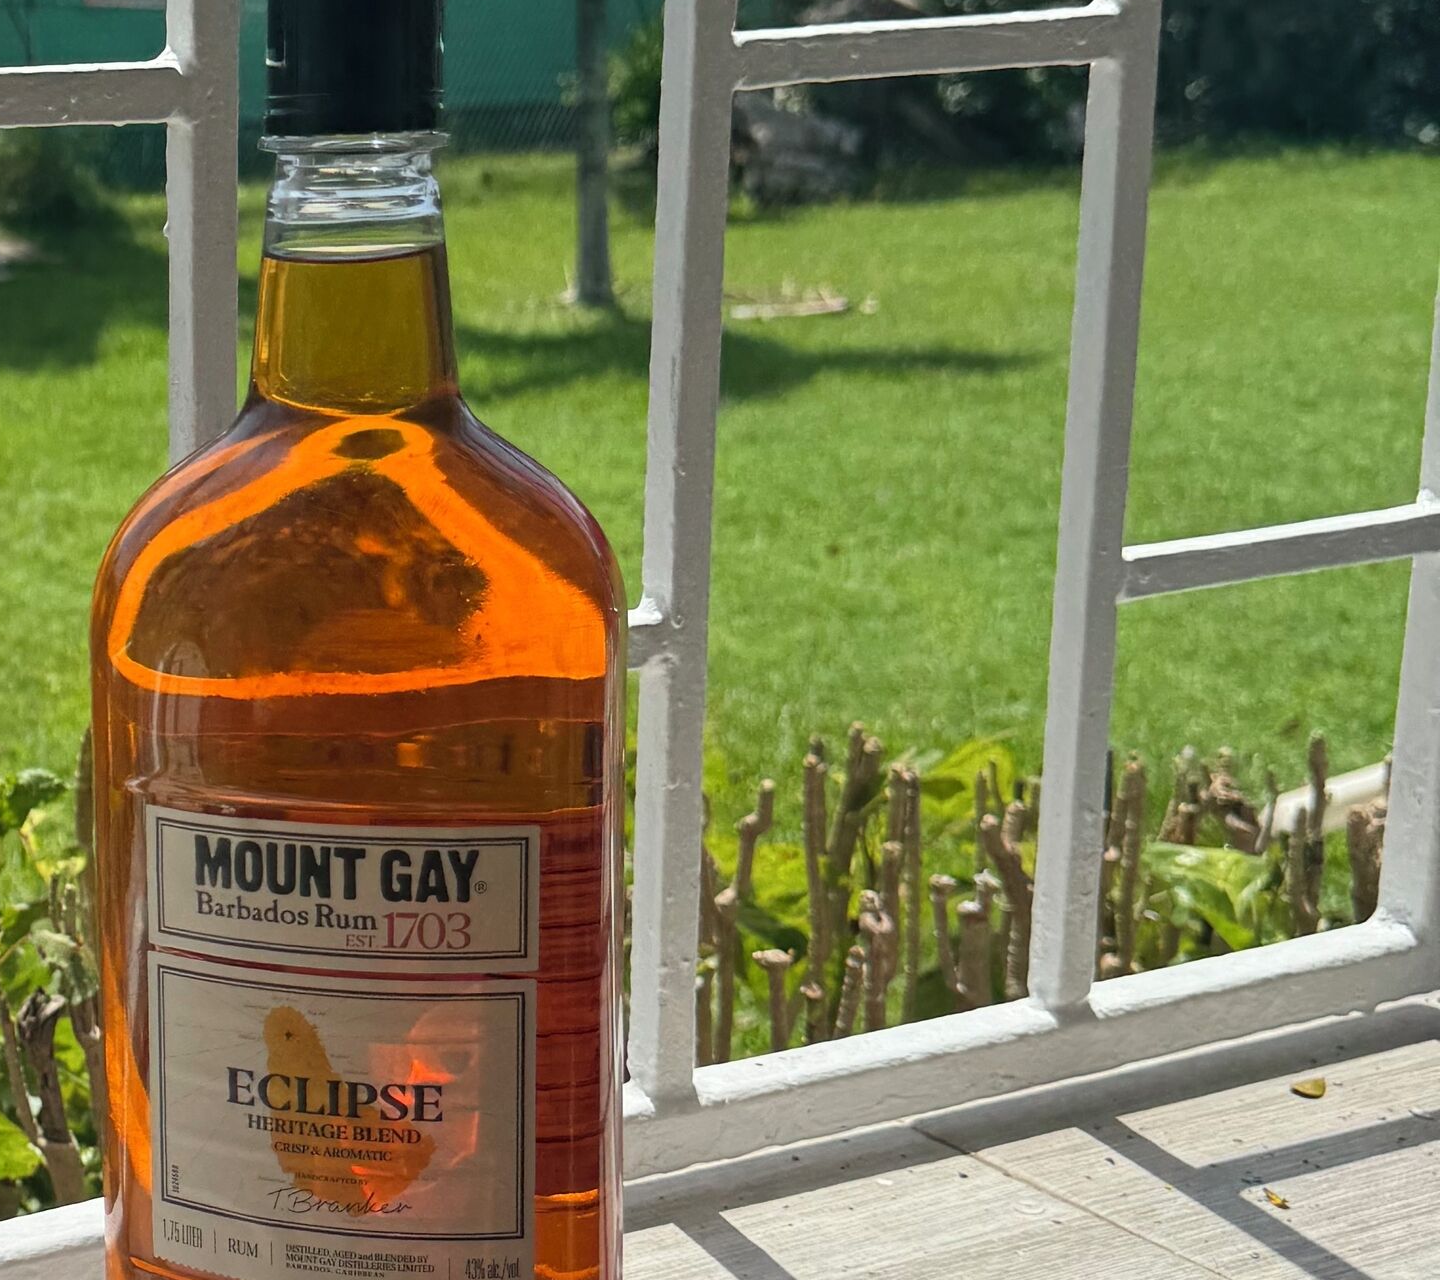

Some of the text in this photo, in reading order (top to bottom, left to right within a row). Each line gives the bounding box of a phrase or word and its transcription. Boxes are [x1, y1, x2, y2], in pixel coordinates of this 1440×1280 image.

[194, 834, 366, 900] MOUNT
[196, 890, 378, 930] Barbados Rum
[381, 911, 471, 950] 1703
[227, 1066, 443, 1122] ECLIPSE
[247, 1113, 421, 1144] HERITAGE BLEND
[274, 1141, 392, 1161] CRISP & AROMATIC
[295, 1171, 357, 1185] HANDCRAFTED
[182, 1224, 202, 1248] LITER
[229, 1237, 258, 1258] RUM
[286, 1253, 435, 1273] MOUNT GAY DISTILLERIES LIMITED
[333, 1250, 357, 1260] AGED
[358, 1252, 373, 1261] and
[375, 1253, 416, 1263] BLENDED
[417, 1255, 429, 1264] BY
[465, 1258, 486, 1280] 43%
